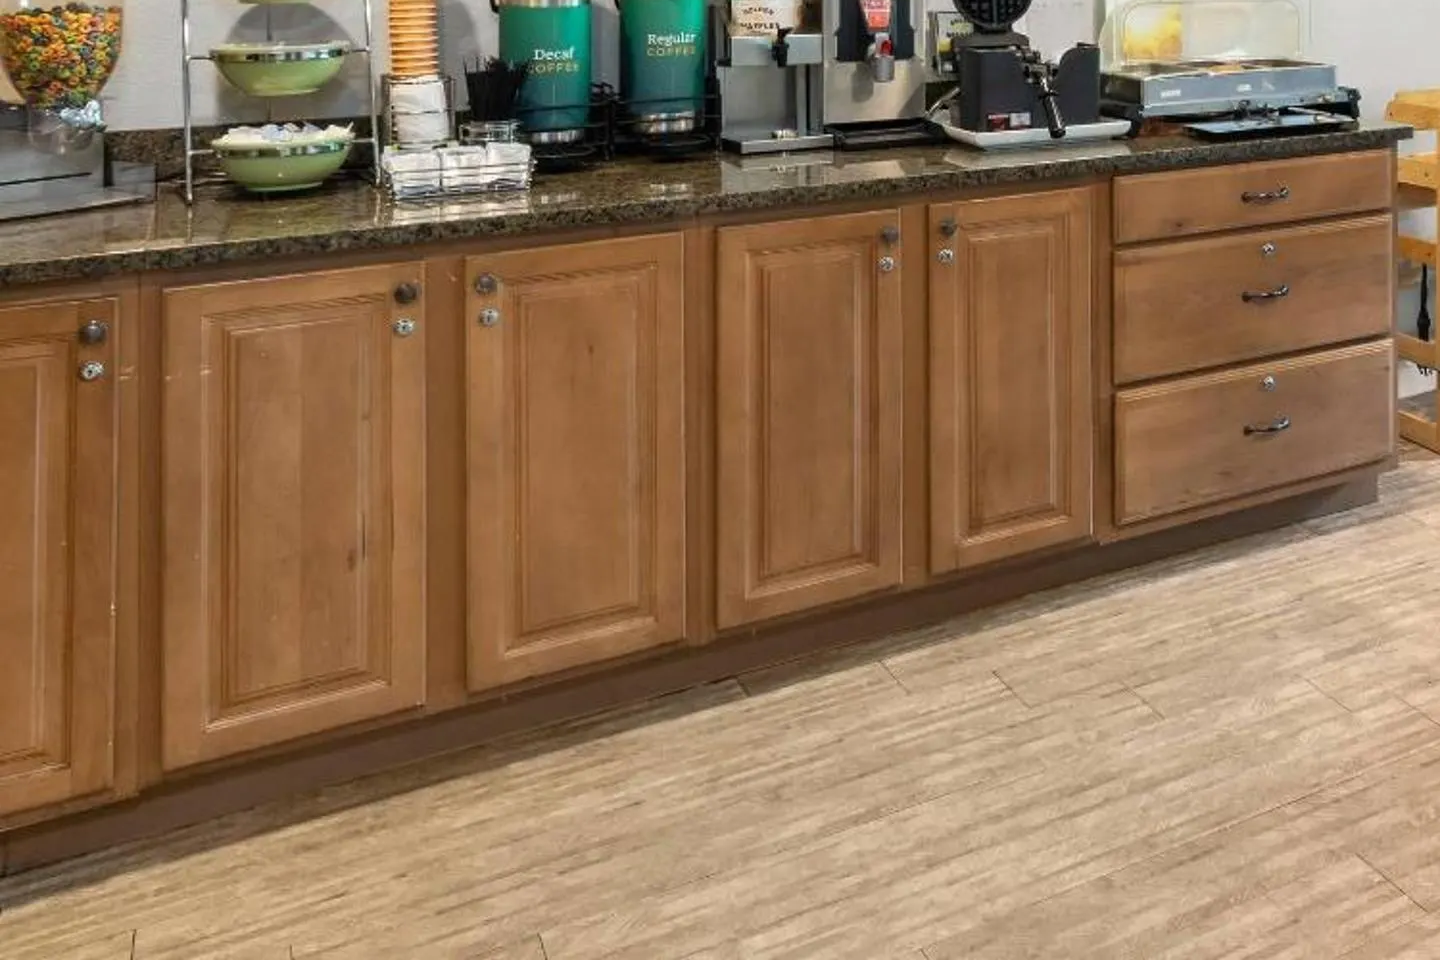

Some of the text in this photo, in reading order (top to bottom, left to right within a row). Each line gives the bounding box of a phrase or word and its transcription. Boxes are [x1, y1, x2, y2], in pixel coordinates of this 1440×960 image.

[647, 32, 697, 46] Regular
[533, 46, 576, 61] Decaf
[646, 46, 696, 57] COFFEE
